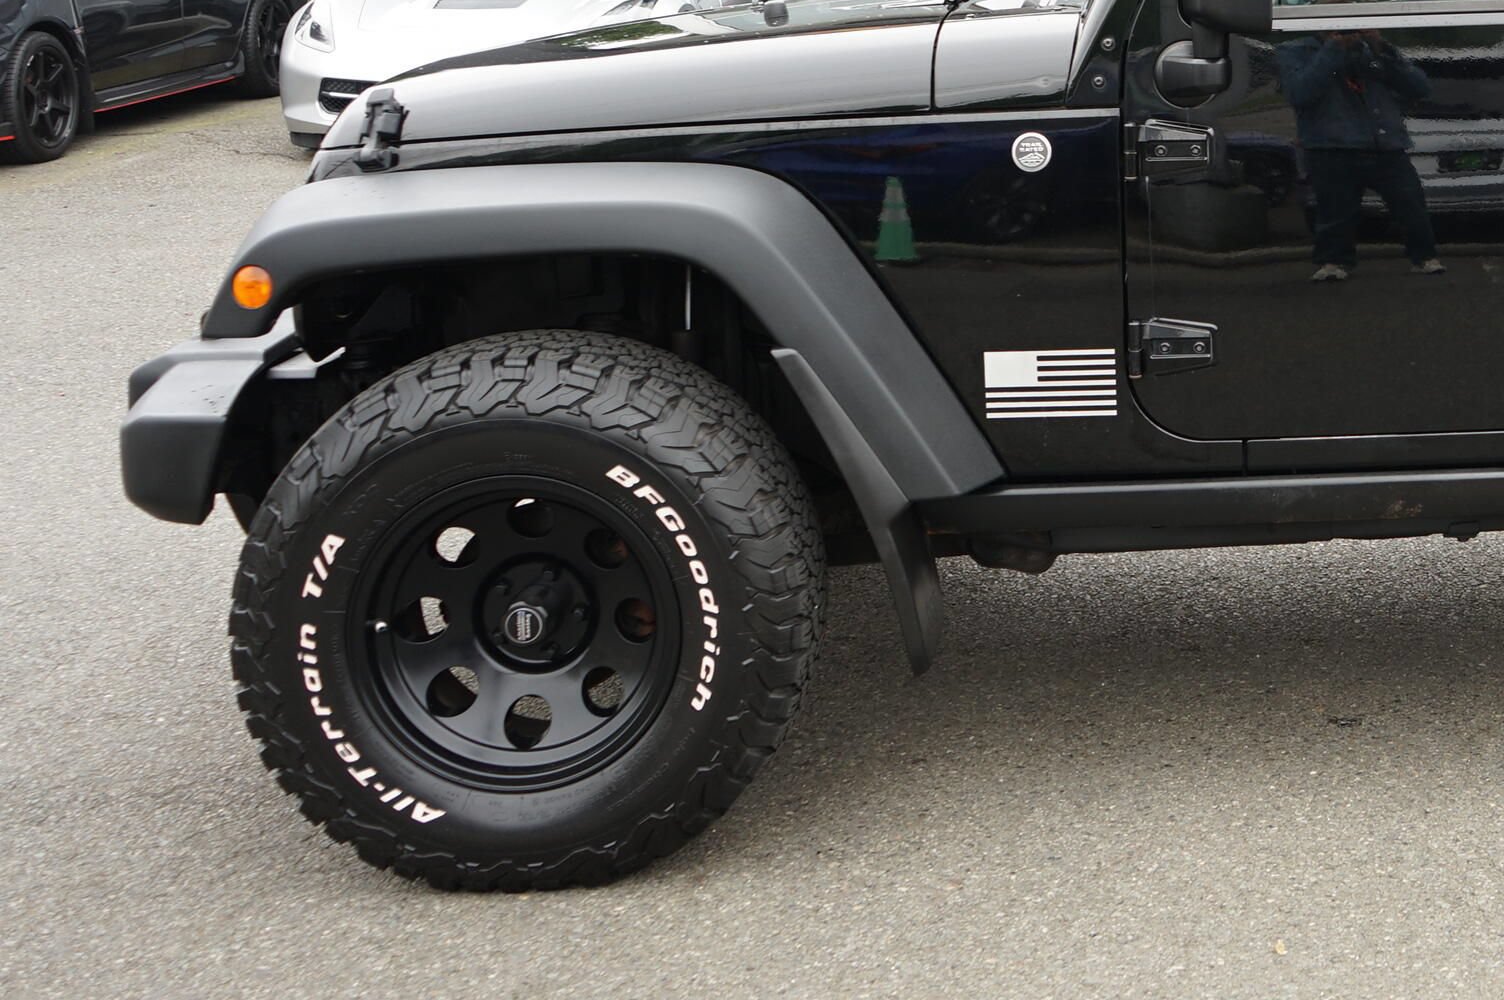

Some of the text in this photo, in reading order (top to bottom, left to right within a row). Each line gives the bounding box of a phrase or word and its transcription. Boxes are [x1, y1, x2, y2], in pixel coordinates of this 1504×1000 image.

[297, 534, 447, 825] All-Terrain T/A
[605, 465, 722, 711] BFGoodrich
